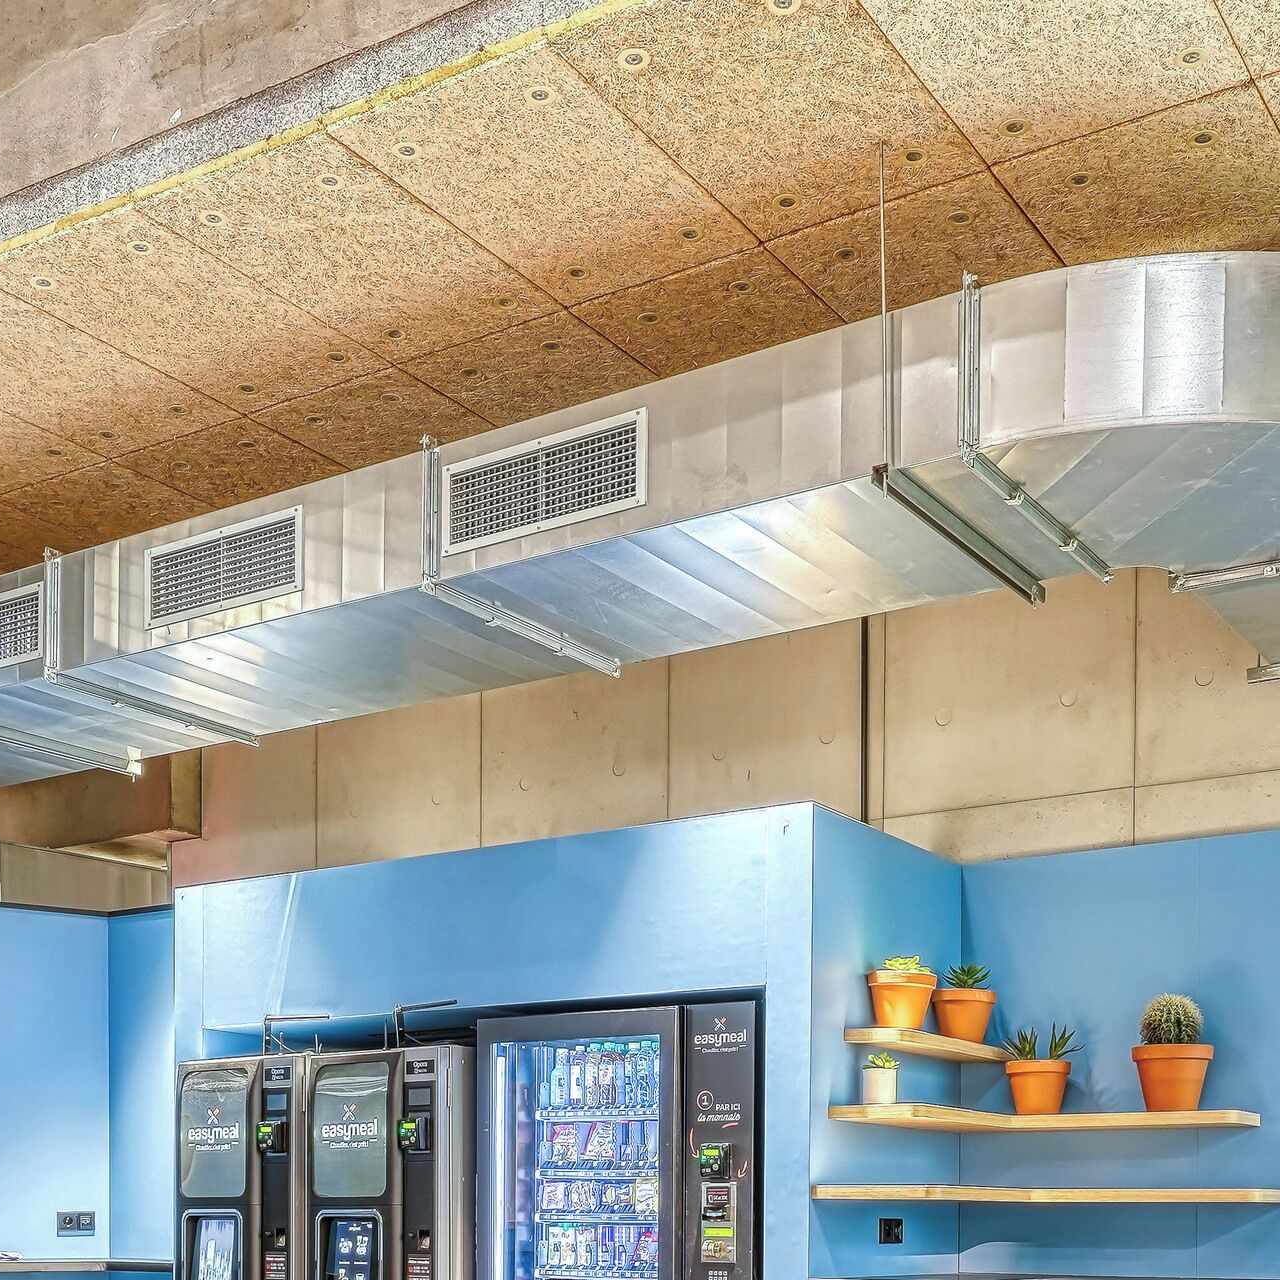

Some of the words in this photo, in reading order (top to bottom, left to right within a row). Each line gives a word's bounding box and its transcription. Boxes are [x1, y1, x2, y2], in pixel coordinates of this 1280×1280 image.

[694, 1028, 747, 1047] easymeal
[697, 1112, 707, 1121] la
[707, 1112, 741, 1121] monnaie
[715, 1103, 730, 1111] PAR
[187, 1121, 240, 1144] easymeal
[321, 1118, 378, 1141] easymeal
